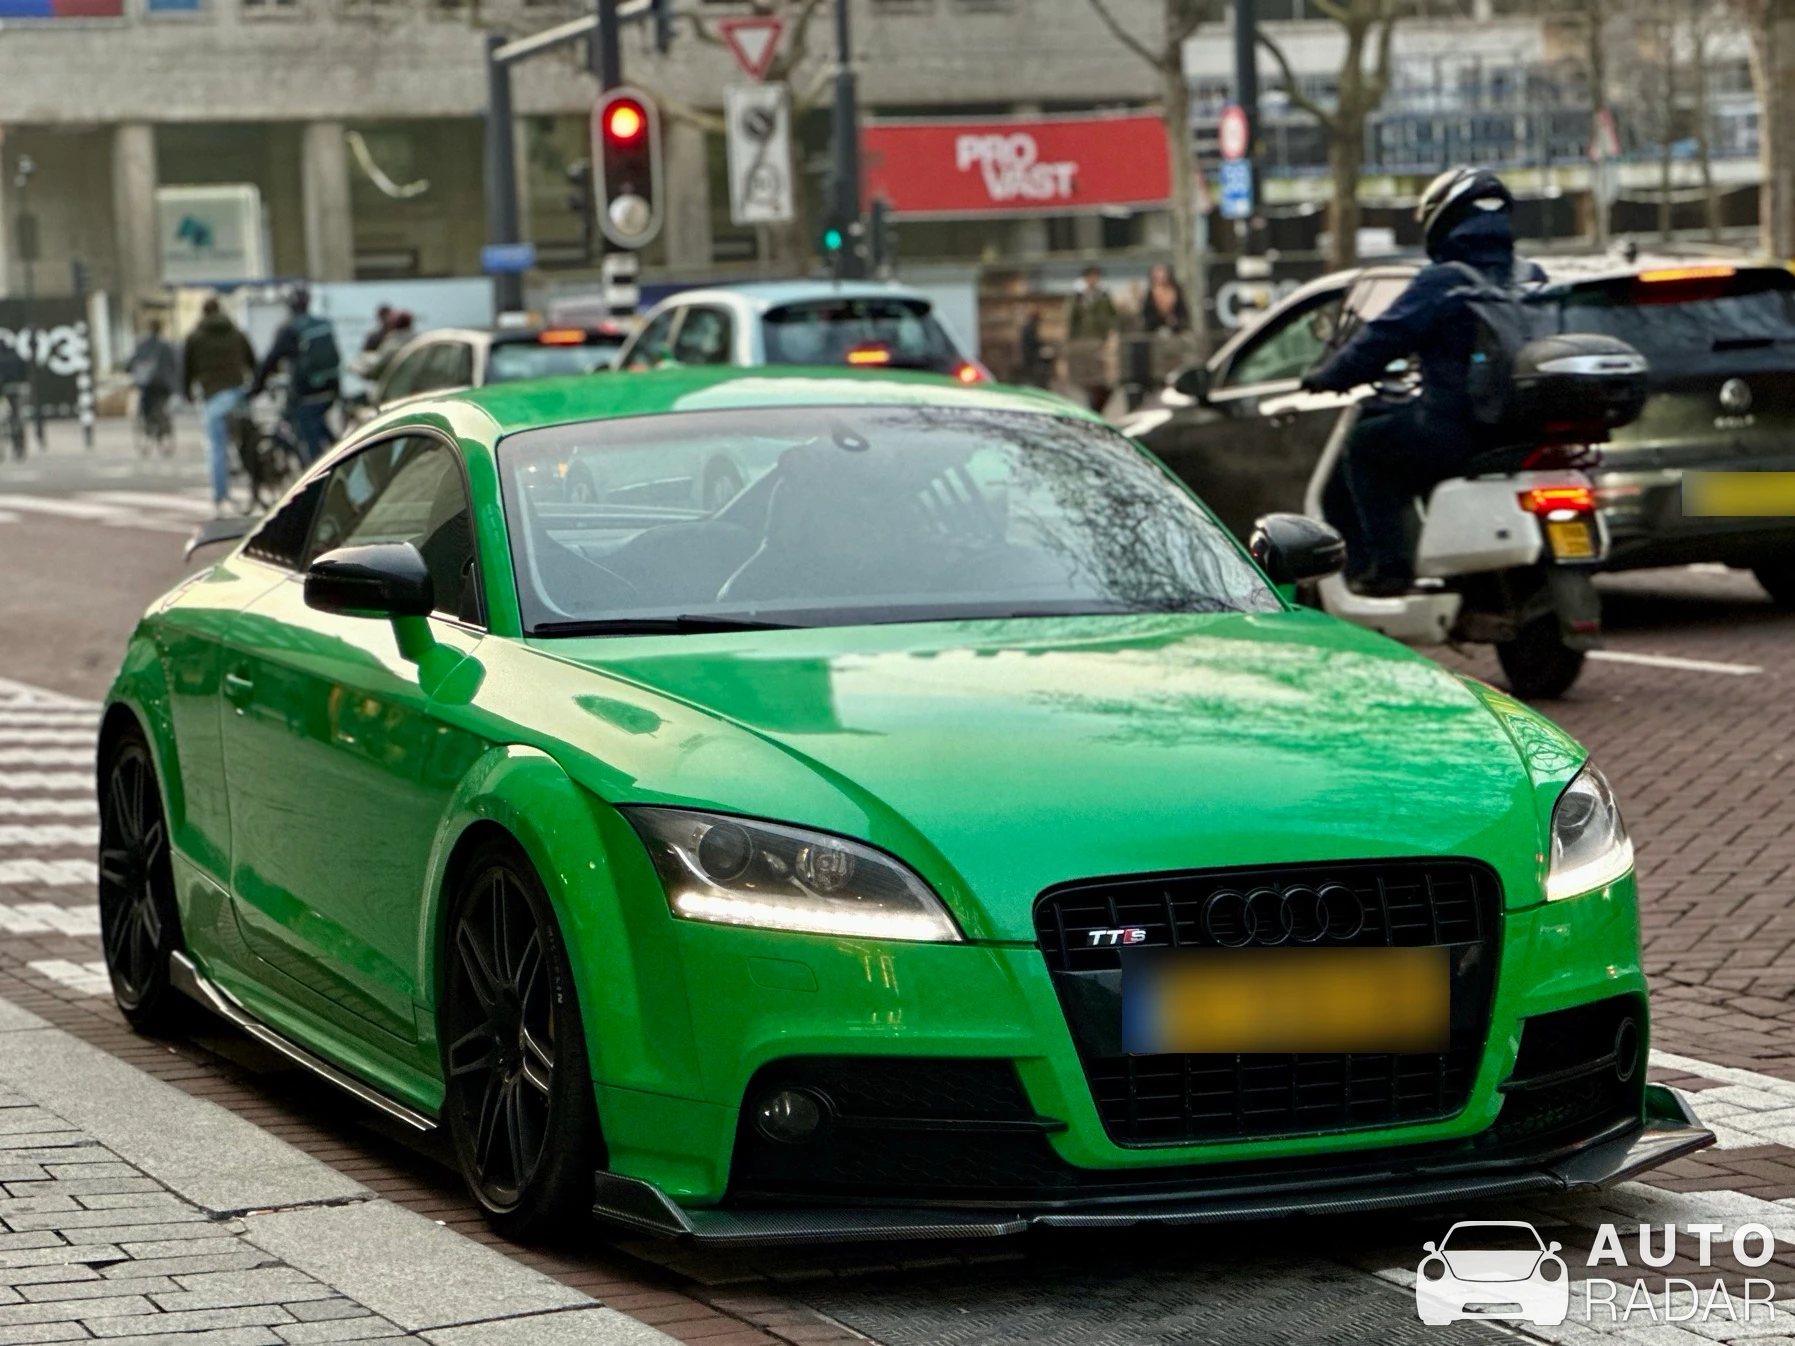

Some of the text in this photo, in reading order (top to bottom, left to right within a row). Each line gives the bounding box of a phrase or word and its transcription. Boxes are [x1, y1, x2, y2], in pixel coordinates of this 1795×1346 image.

[956, 133, 1037, 171] PRO
[981, 162, 1079, 200] VAST
[1088, 929, 1147, 946] TTS
